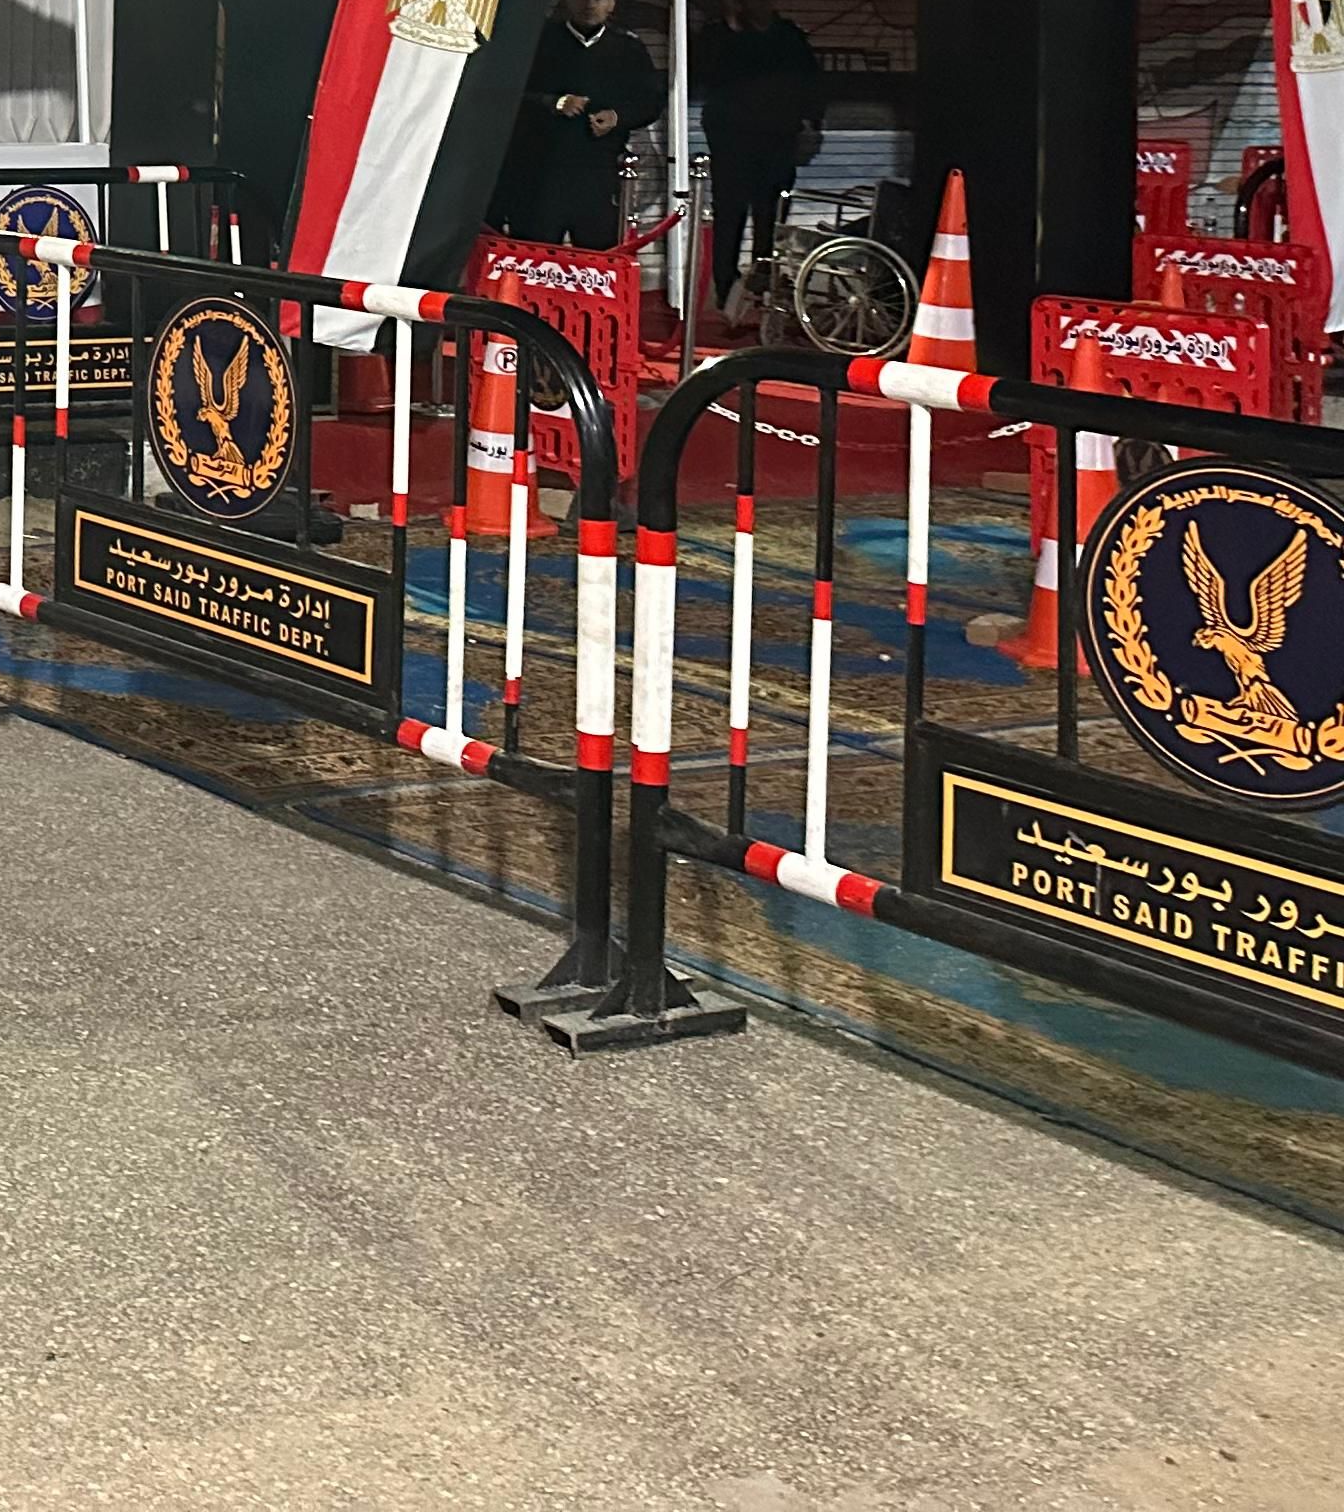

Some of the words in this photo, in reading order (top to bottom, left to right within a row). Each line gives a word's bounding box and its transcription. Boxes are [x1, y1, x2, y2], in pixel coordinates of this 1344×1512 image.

[35, 368, 89, 383] TRAFIC
[93, 367, 130, 381] DEPT.
[108, 538, 210, 589] بورسعيد
[106, 567, 147, 596] PORT
[152, 582, 192, 610] SAID
[197, 596, 272, 637] TRAFFIC
[278, 622, 330, 657] DEPT.
[212, 574, 274, 603] مرور
[279, 583, 332, 630] إدارة
[1016, 820, 1233, 912] بورسعيد
[1012, 861, 1097, 910] PORT
[1112, 893, 1195, 941] SAID
[1211, 922, 1344, 990] TRAFFI
[1240, 893, 1344, 939] رور
